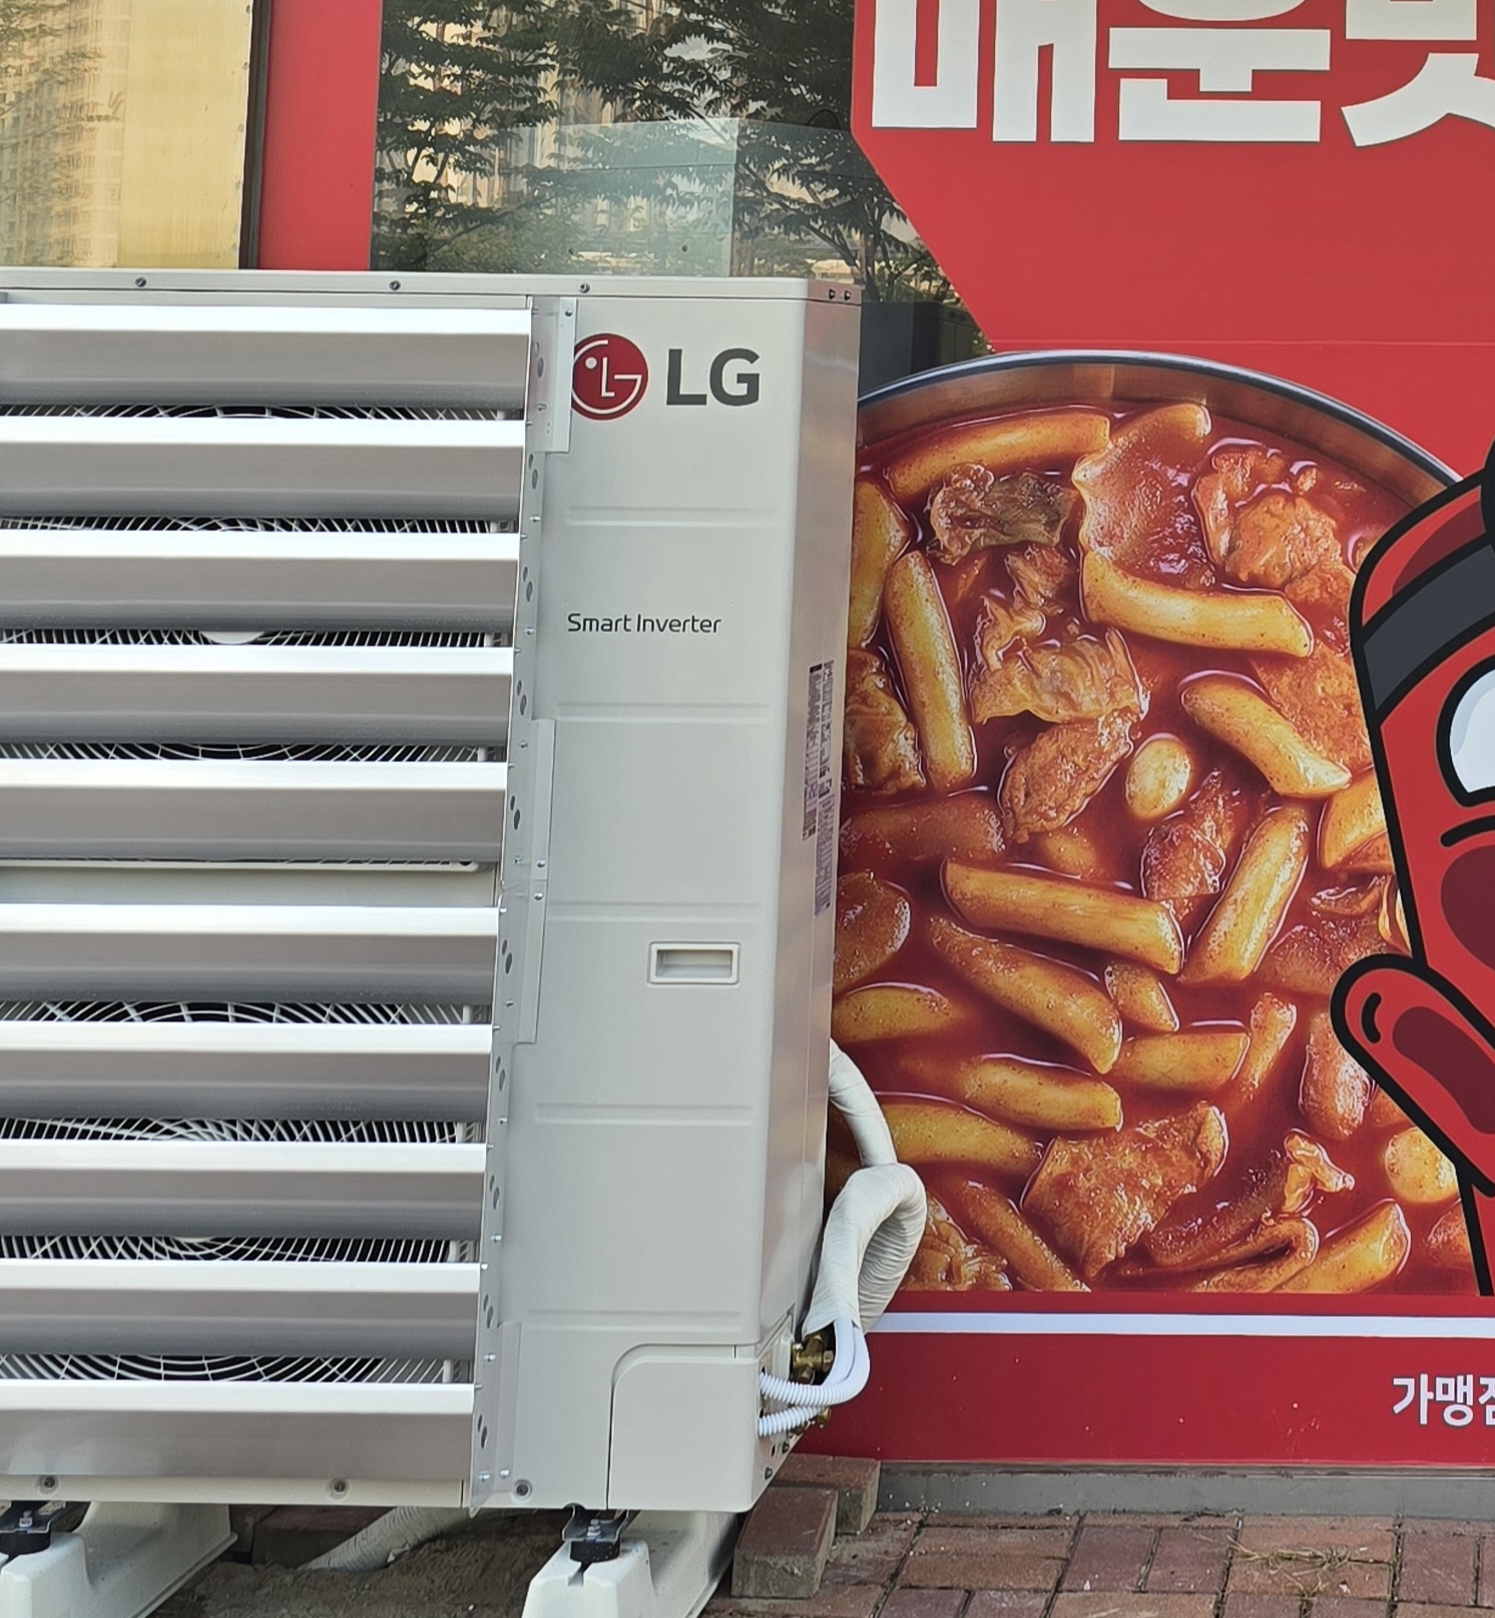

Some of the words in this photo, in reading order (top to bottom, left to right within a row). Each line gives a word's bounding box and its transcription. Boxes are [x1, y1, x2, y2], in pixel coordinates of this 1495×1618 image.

[666, 347, 761, 407] LG
[567, 613, 632, 633] Smart
[636, 613, 722, 634] Inverter
